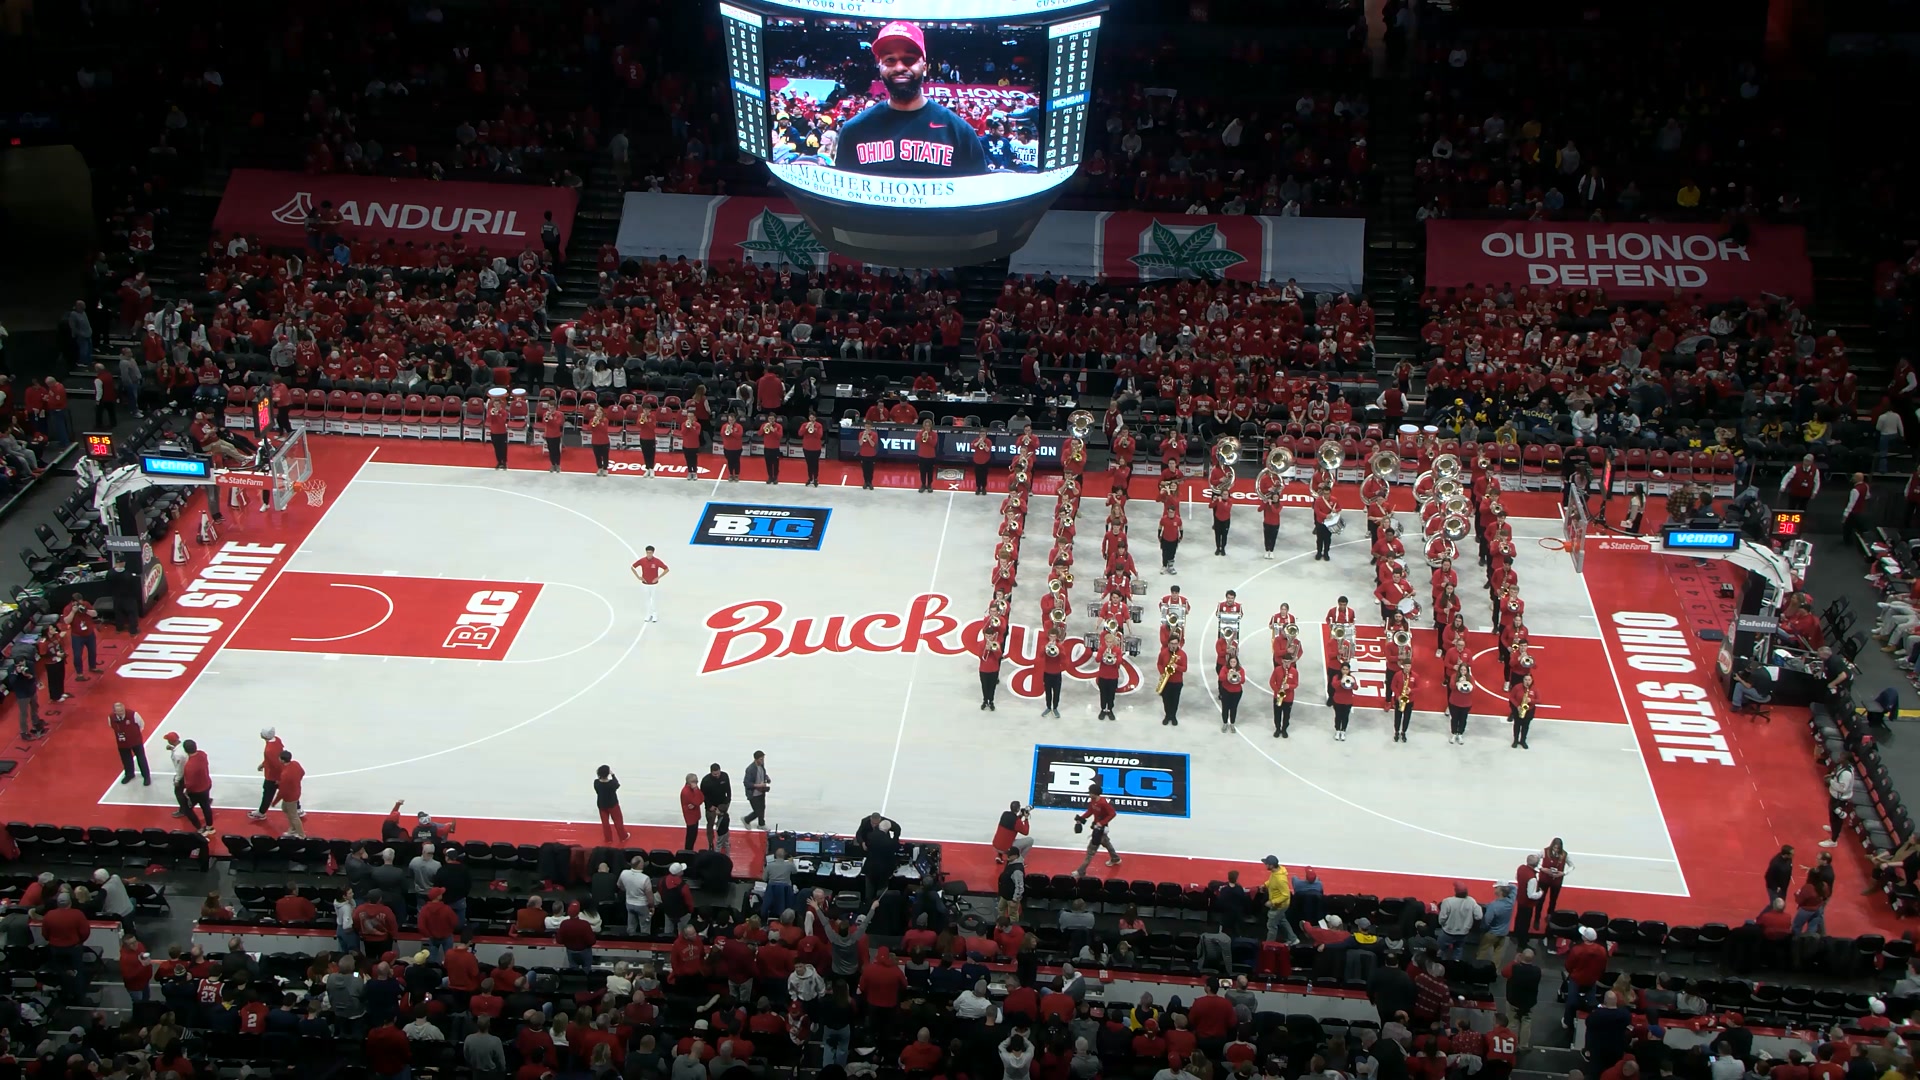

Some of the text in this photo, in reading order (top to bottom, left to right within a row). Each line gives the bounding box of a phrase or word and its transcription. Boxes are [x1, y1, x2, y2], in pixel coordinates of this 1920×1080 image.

[807, 0, 835, 9] YOUR
[1057, 38, 1089, 54] 0 2 0
[1082, 49, 1088, 59] 0
[1081, 60, 1087, 69] 0
[1067, 74, 1074, 84] 0
[1080, 71, 1086, 80] 0
[921, 87, 952, 97] UR
[1066, 84, 1073, 94] 2
[1079, 81, 1086, 91] 0
[1076, 112, 1083, 121] 0
[856, 139, 955, 167] OHIO STATE
[1073, 153, 1079, 162] 0
[781, 170, 811, 187] CUSTOM
[848, 191, 862, 200] ON
[868, 194, 897, 204] YOUR
[880, 182, 956, 197] HOMES
[338, 200, 527, 237] ANDURIL
[1481, 232, 1751, 261] OUR HONOR
[1528, 263, 1708, 288] DEFEND
[89, 436, 111, 445] 13:15
[880, 438, 916, 450] YETI
[93, 444, 108, 455] 30
[998, 445, 1007, 453] IN
[151, 459, 199, 472] venmo
[744, 508, 791, 517] venmo
[1777, 513, 1801, 523] 13:15
[1779, 523, 1794, 535] 30
[1677, 532, 1729, 545] venmo
[116, 541, 287, 679] OHIO STATE
[1739, 618, 1778, 629] Safelite
[1611, 611, 1736, 766] OHIO STATE
[1083, 755, 1140, 766] venmo
[1115, 799, 1149, 807] SERIES
[201, 991, 216, 1003] 23
[247, 1012, 258, 1028] 2
[1493, 1035, 1515, 1054] 16
